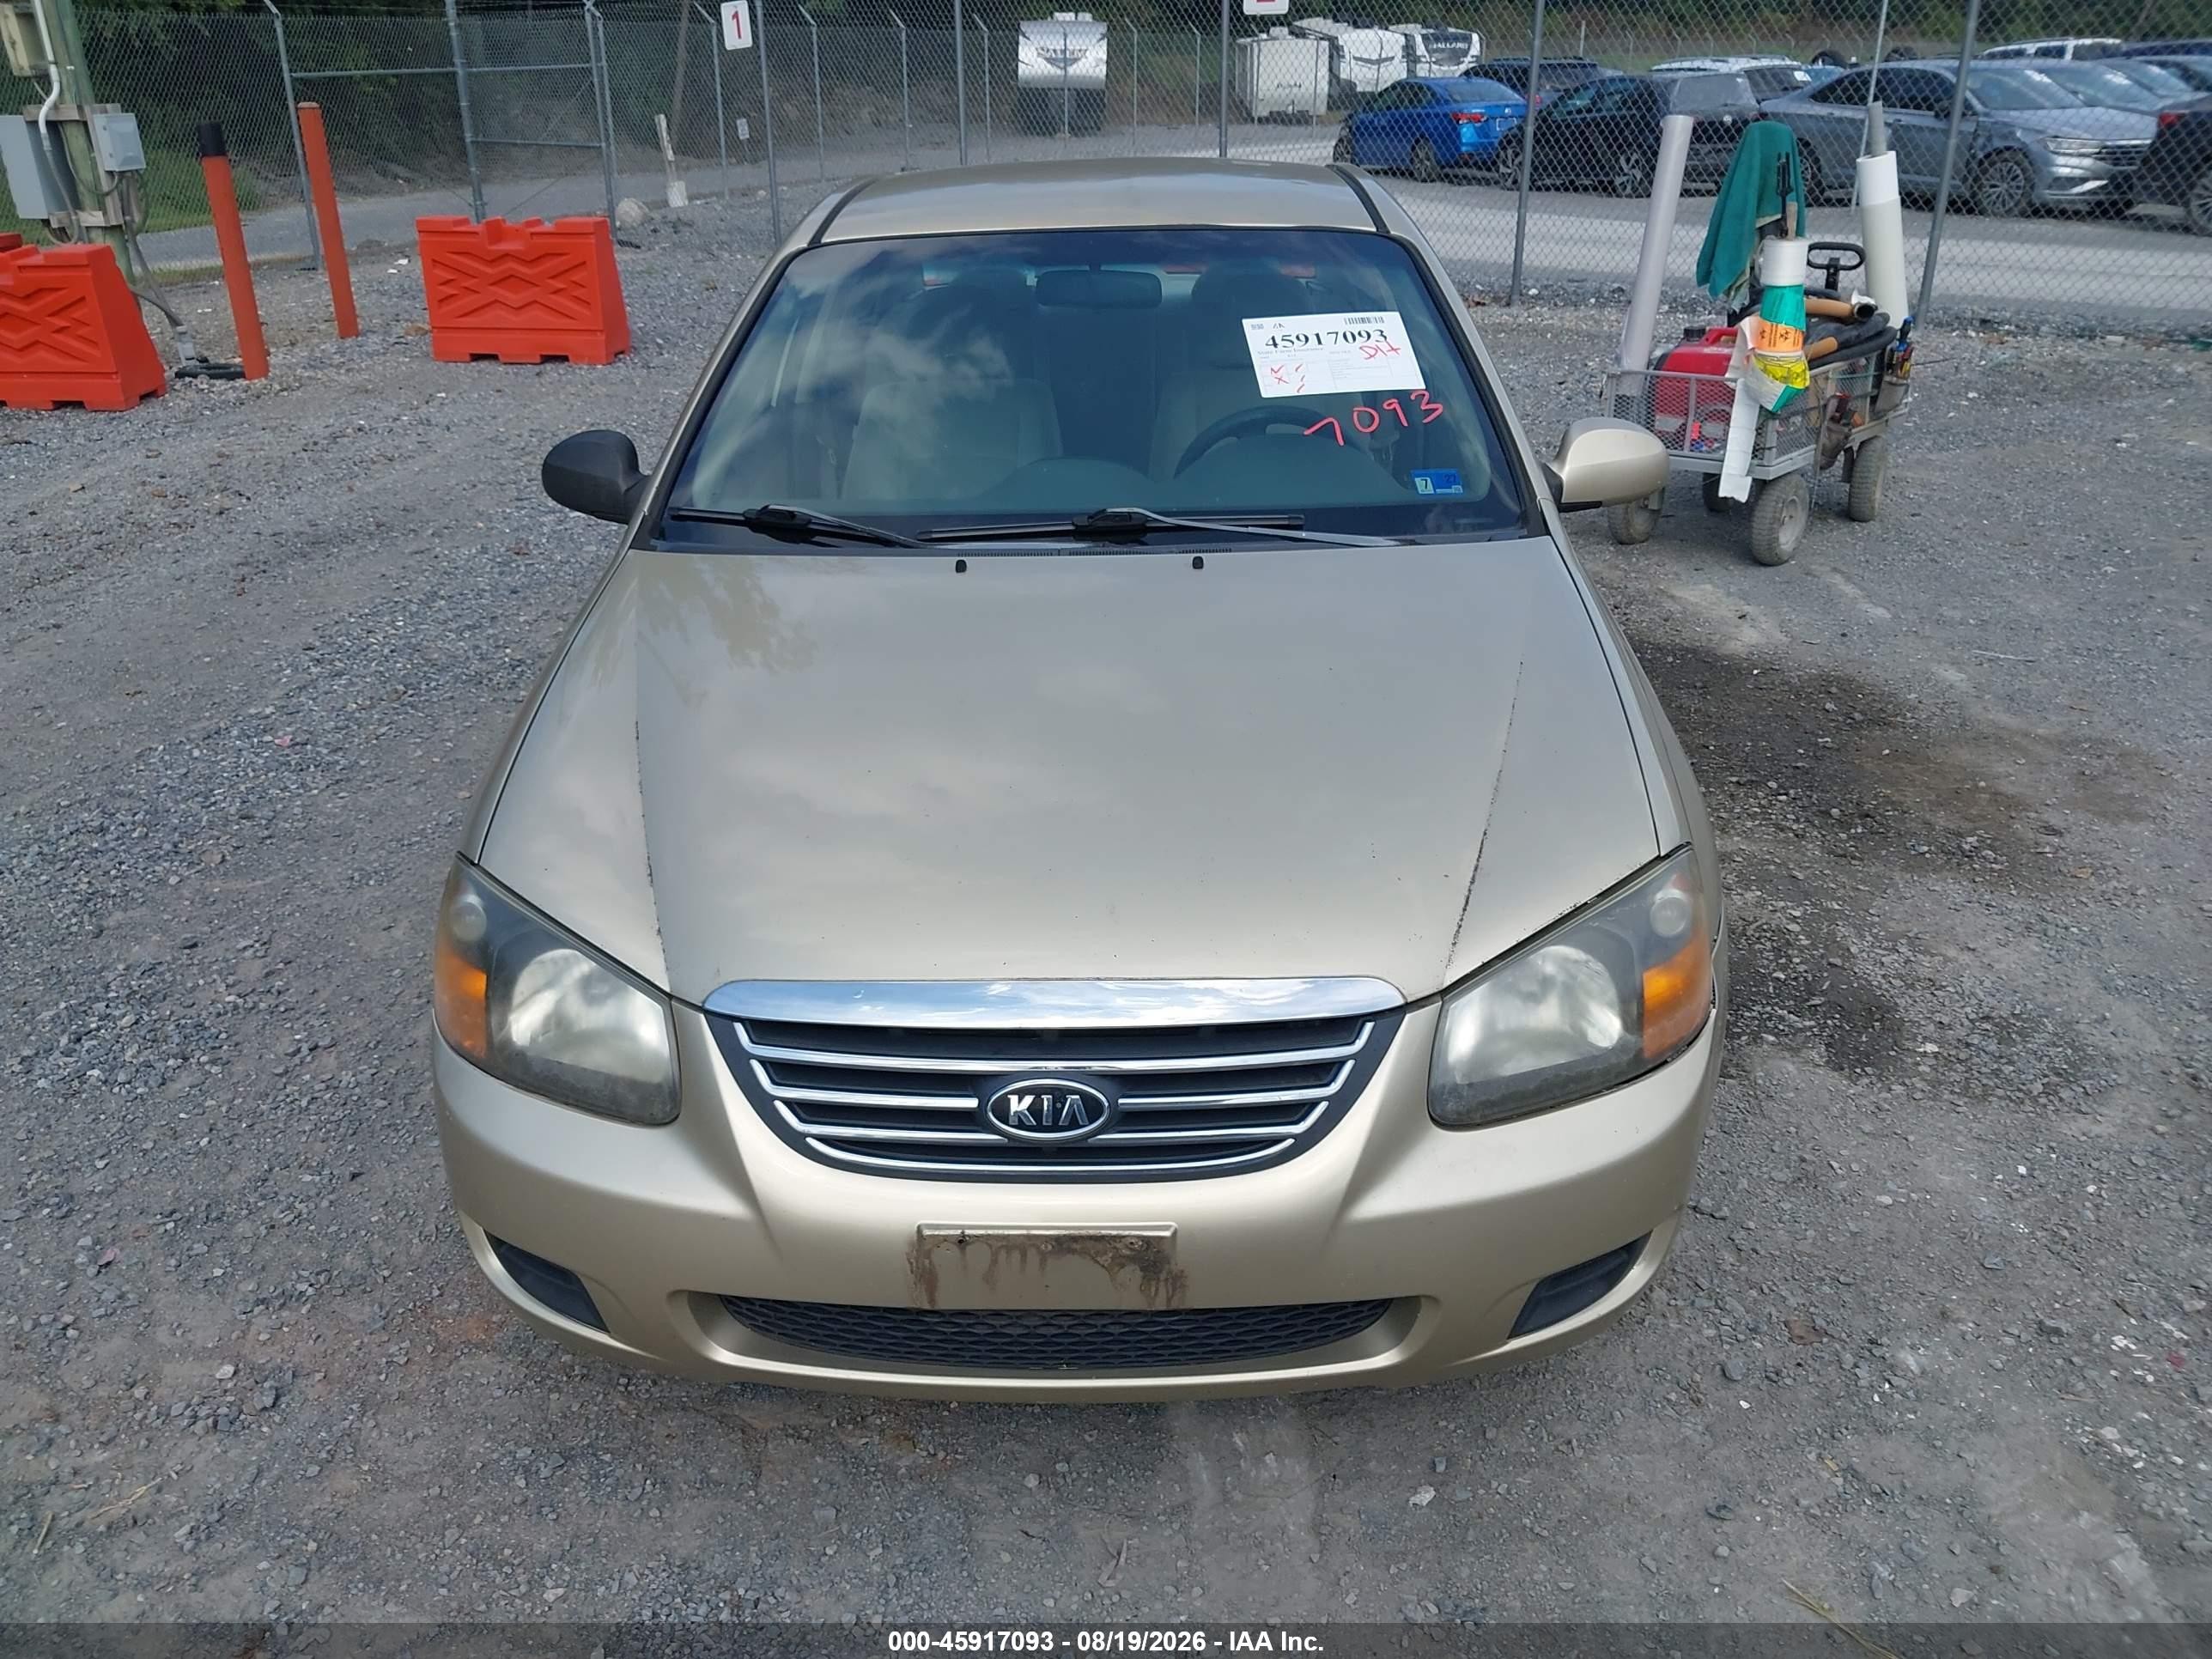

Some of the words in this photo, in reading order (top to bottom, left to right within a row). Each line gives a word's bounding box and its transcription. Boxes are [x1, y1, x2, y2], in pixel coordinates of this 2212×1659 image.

[732, 10, 742, 40] 1
[1265, 329, 1388, 349] 45917093
[1303, 390, 1443, 447] 7093
[1420, 478, 1428, 489] 7
[1006, 1095, 1090, 1126] KIA
